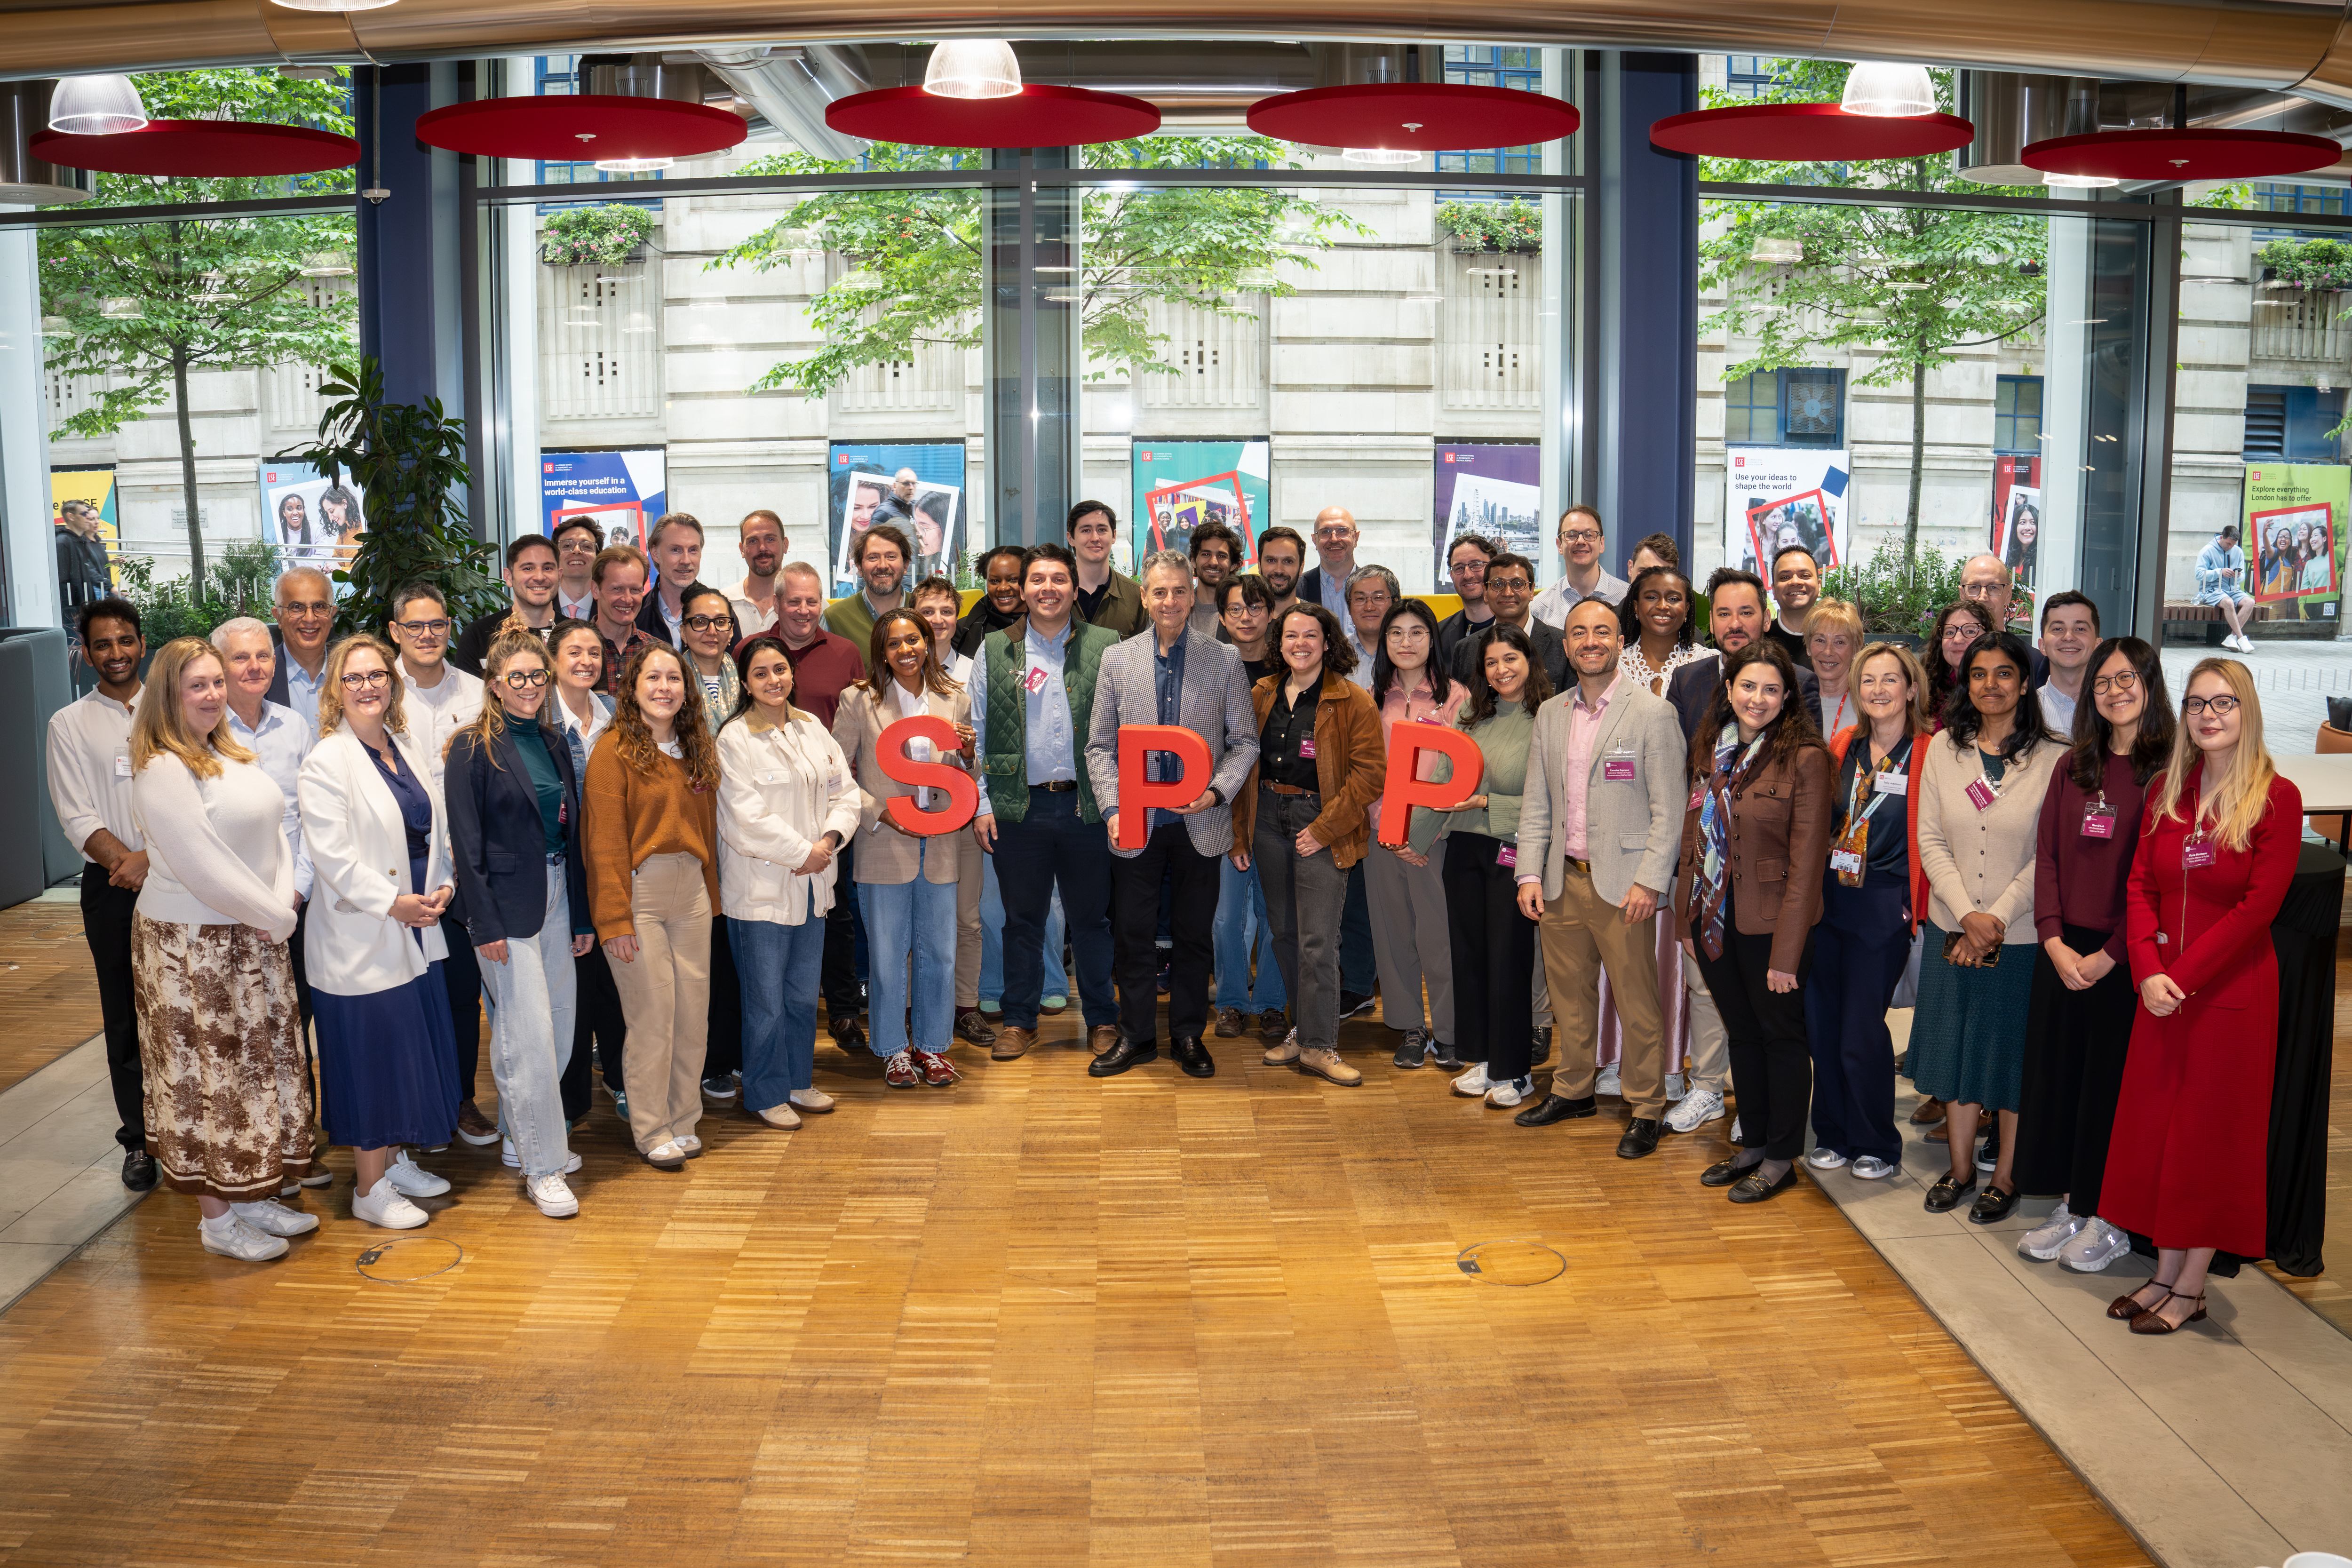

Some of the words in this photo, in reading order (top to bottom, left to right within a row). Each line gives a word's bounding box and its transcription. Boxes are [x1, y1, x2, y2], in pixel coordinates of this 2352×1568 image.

[579, 477, 610, 487] yourself
[1735, 482, 1756, 491] shape
[2277, 486, 2309, 494] everything
[876, 715, 979, 835] S
[1118, 724, 1213, 849] P
[1377, 720, 1484, 846] P
